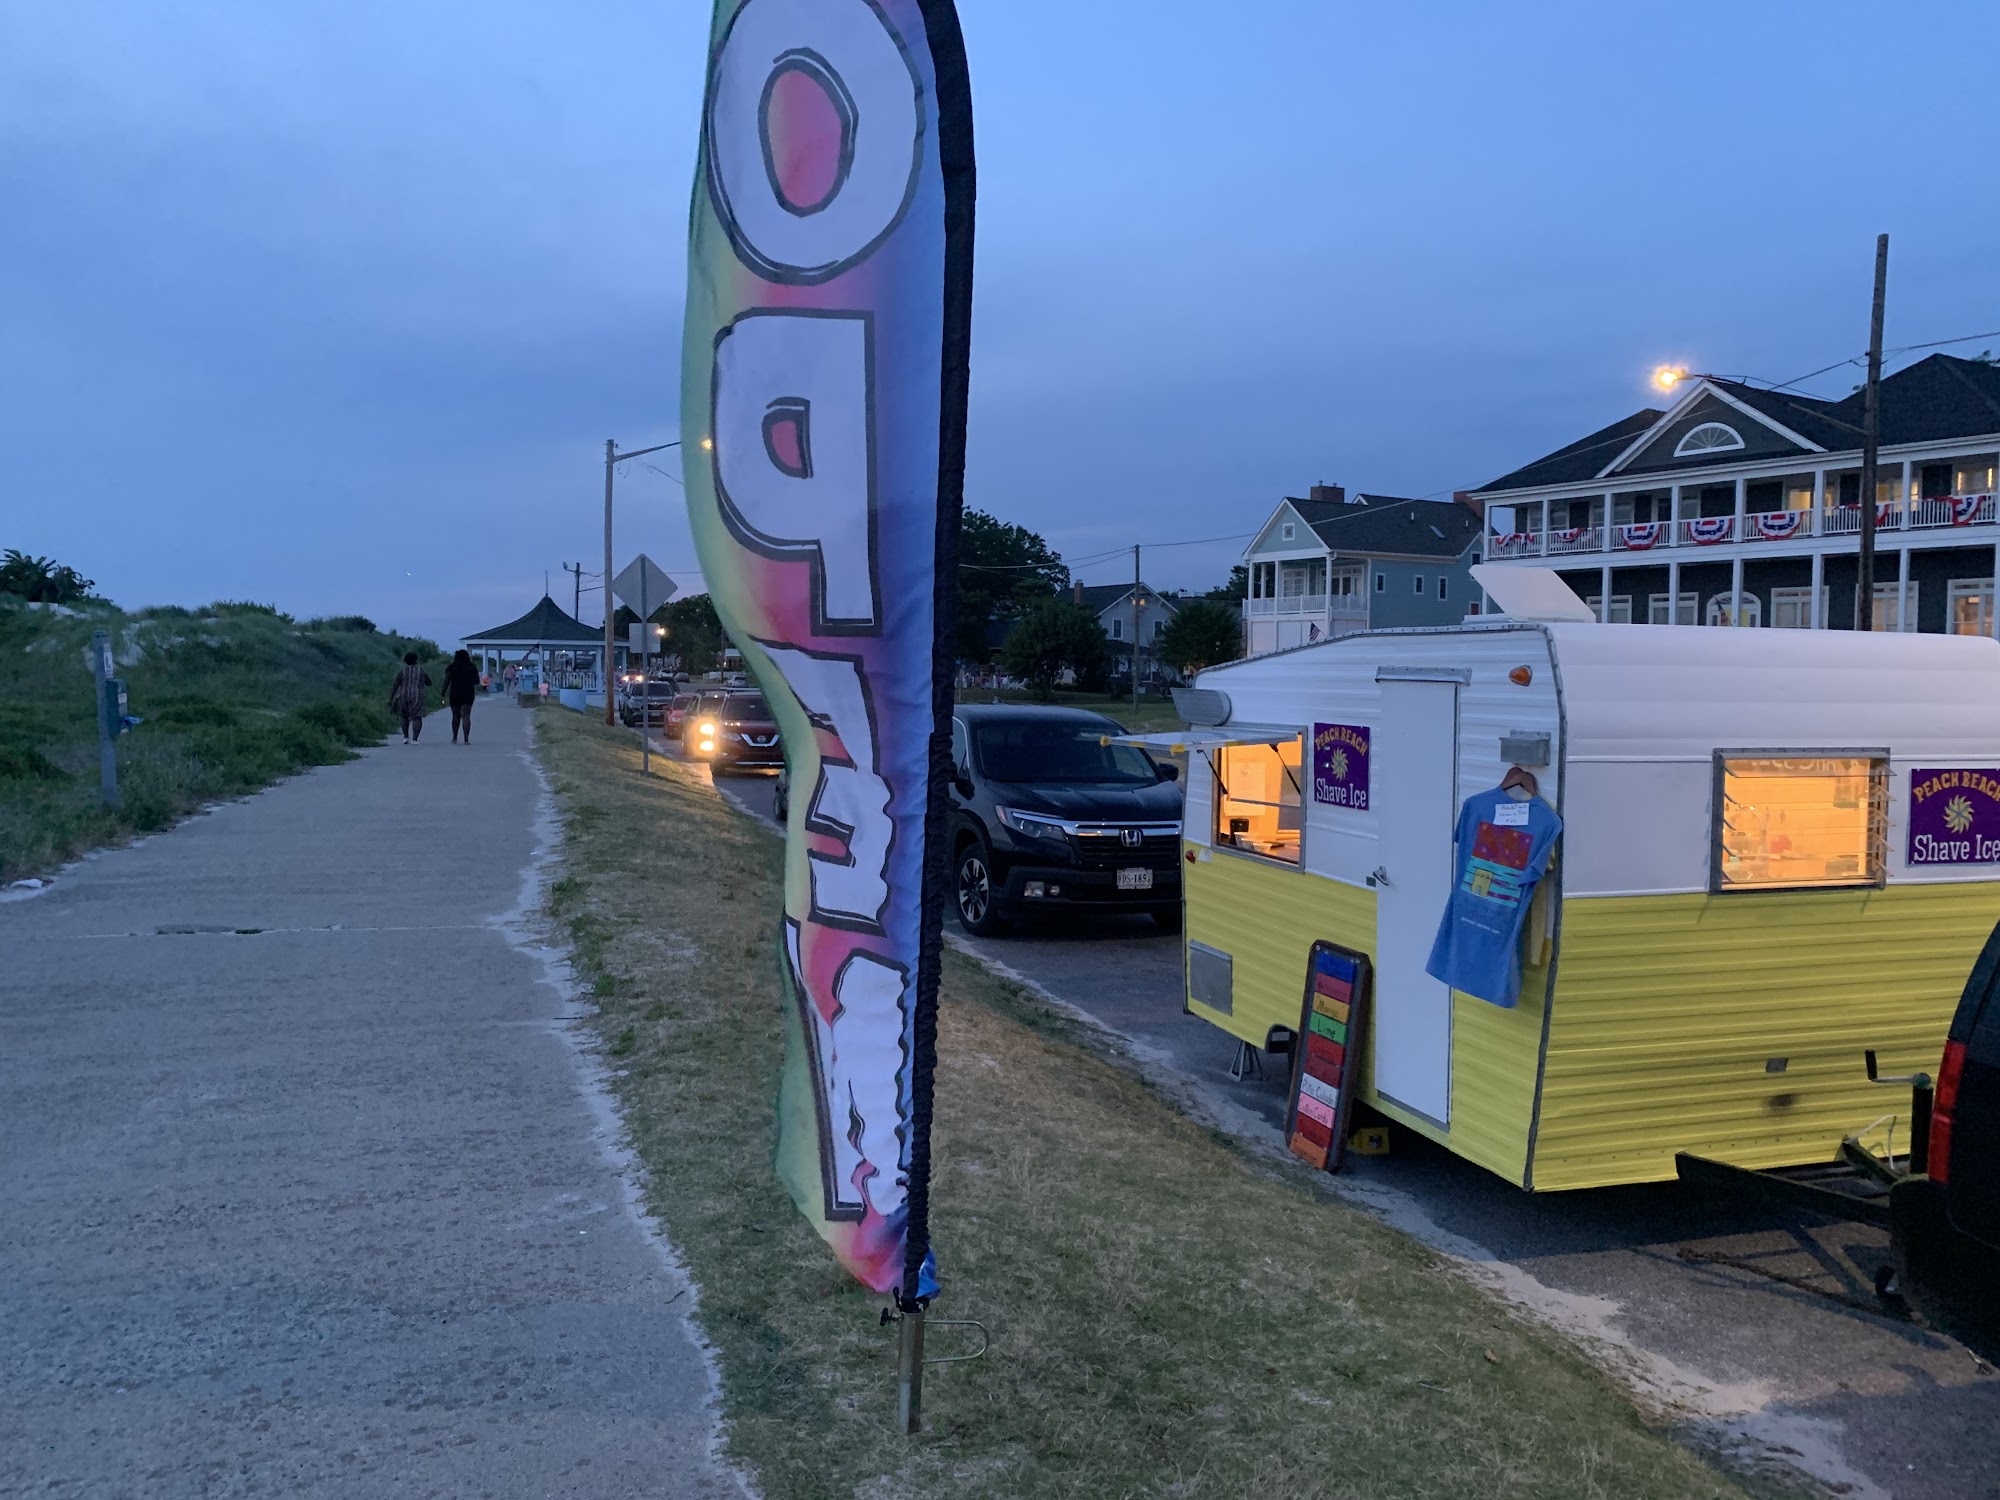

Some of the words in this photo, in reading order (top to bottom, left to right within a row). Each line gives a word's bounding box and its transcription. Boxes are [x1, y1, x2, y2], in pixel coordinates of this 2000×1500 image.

[1314, 728, 1340, 752] PEACH
[1341, 726, 1368, 756] BEACH
[1316, 777, 1347, 805] Shave
[1349, 783, 1367, 807] Ice
[1913, 771, 1960, 804] PEACH
[1913, 834, 1970, 861] Shave
[1974, 833, 2000, 860] Ice
[1317, 1019, 1336, 1039] Lime
